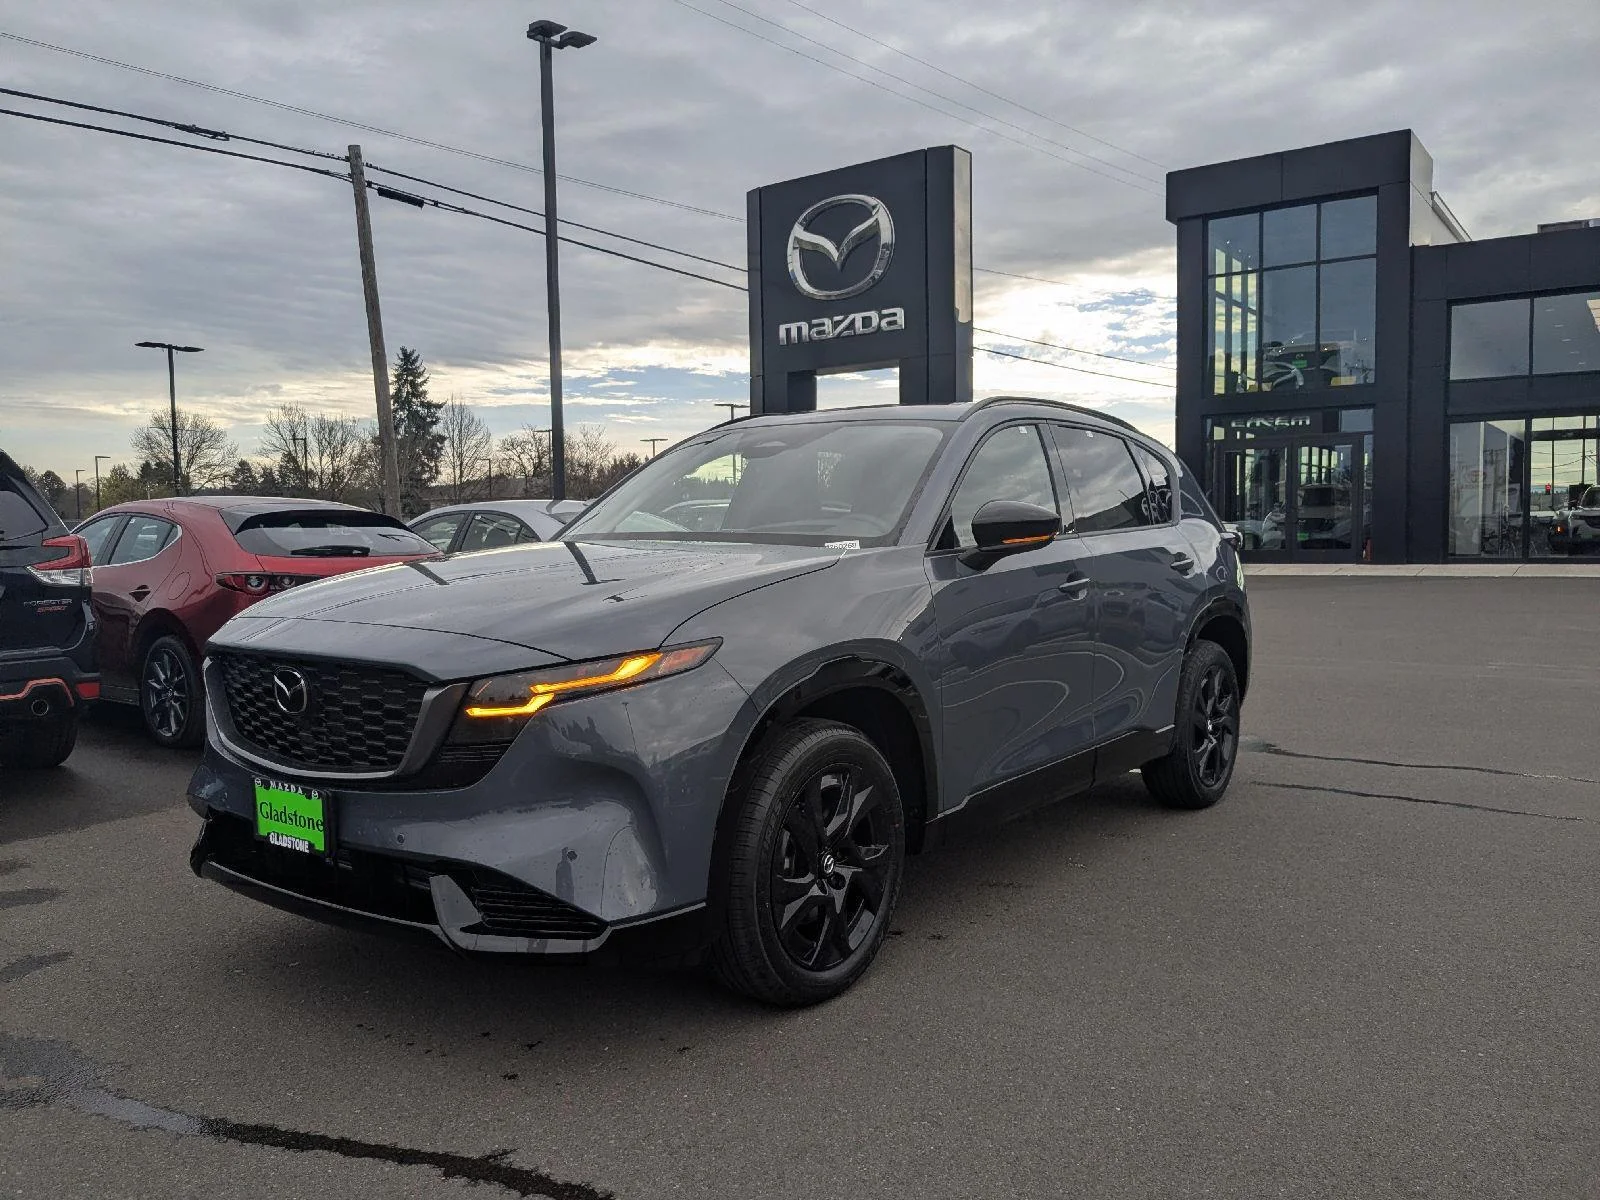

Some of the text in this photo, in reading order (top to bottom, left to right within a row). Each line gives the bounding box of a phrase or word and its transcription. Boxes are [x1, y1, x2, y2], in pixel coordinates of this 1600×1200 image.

[779, 307, 905, 345] mazda
[270, 781, 303, 795] MAZDA
[260, 801, 324, 832] Gladstone
[269, 832, 309, 853] GLADSTONE
